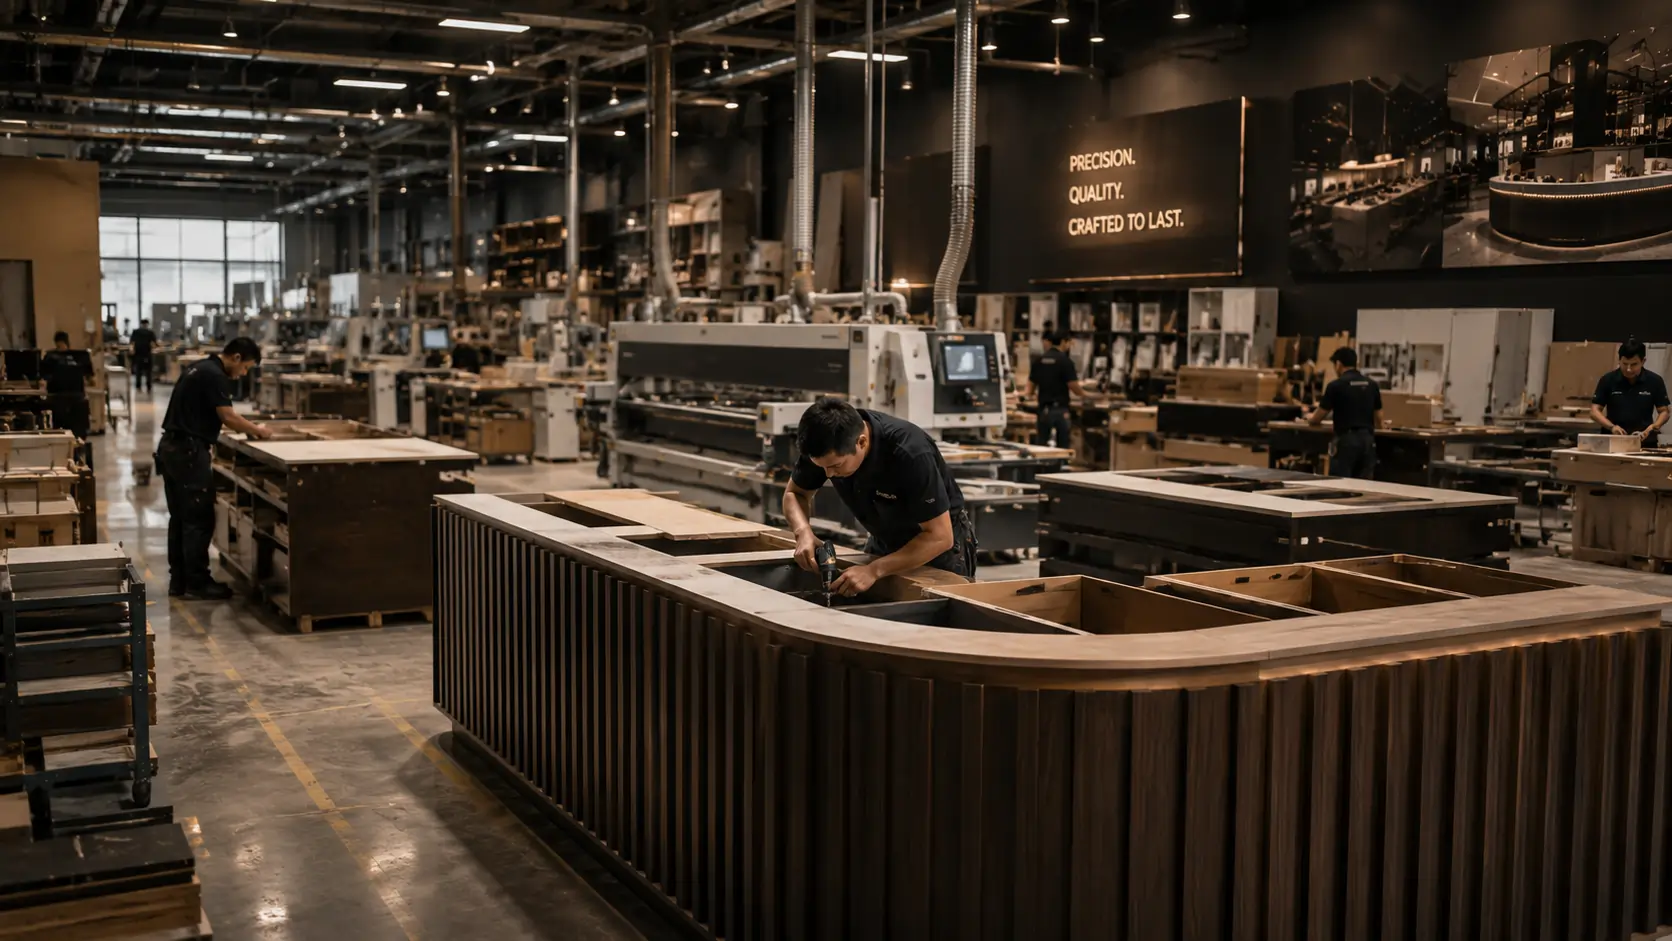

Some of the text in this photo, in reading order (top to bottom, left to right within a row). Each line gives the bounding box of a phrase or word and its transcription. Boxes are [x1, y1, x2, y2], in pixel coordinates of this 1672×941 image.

[1069, 148, 1136, 172] PRECISION.
[1068, 182, 1125, 205] QUALITY.
[1068, 209, 1184, 236] CRAFTED TO LAST.
